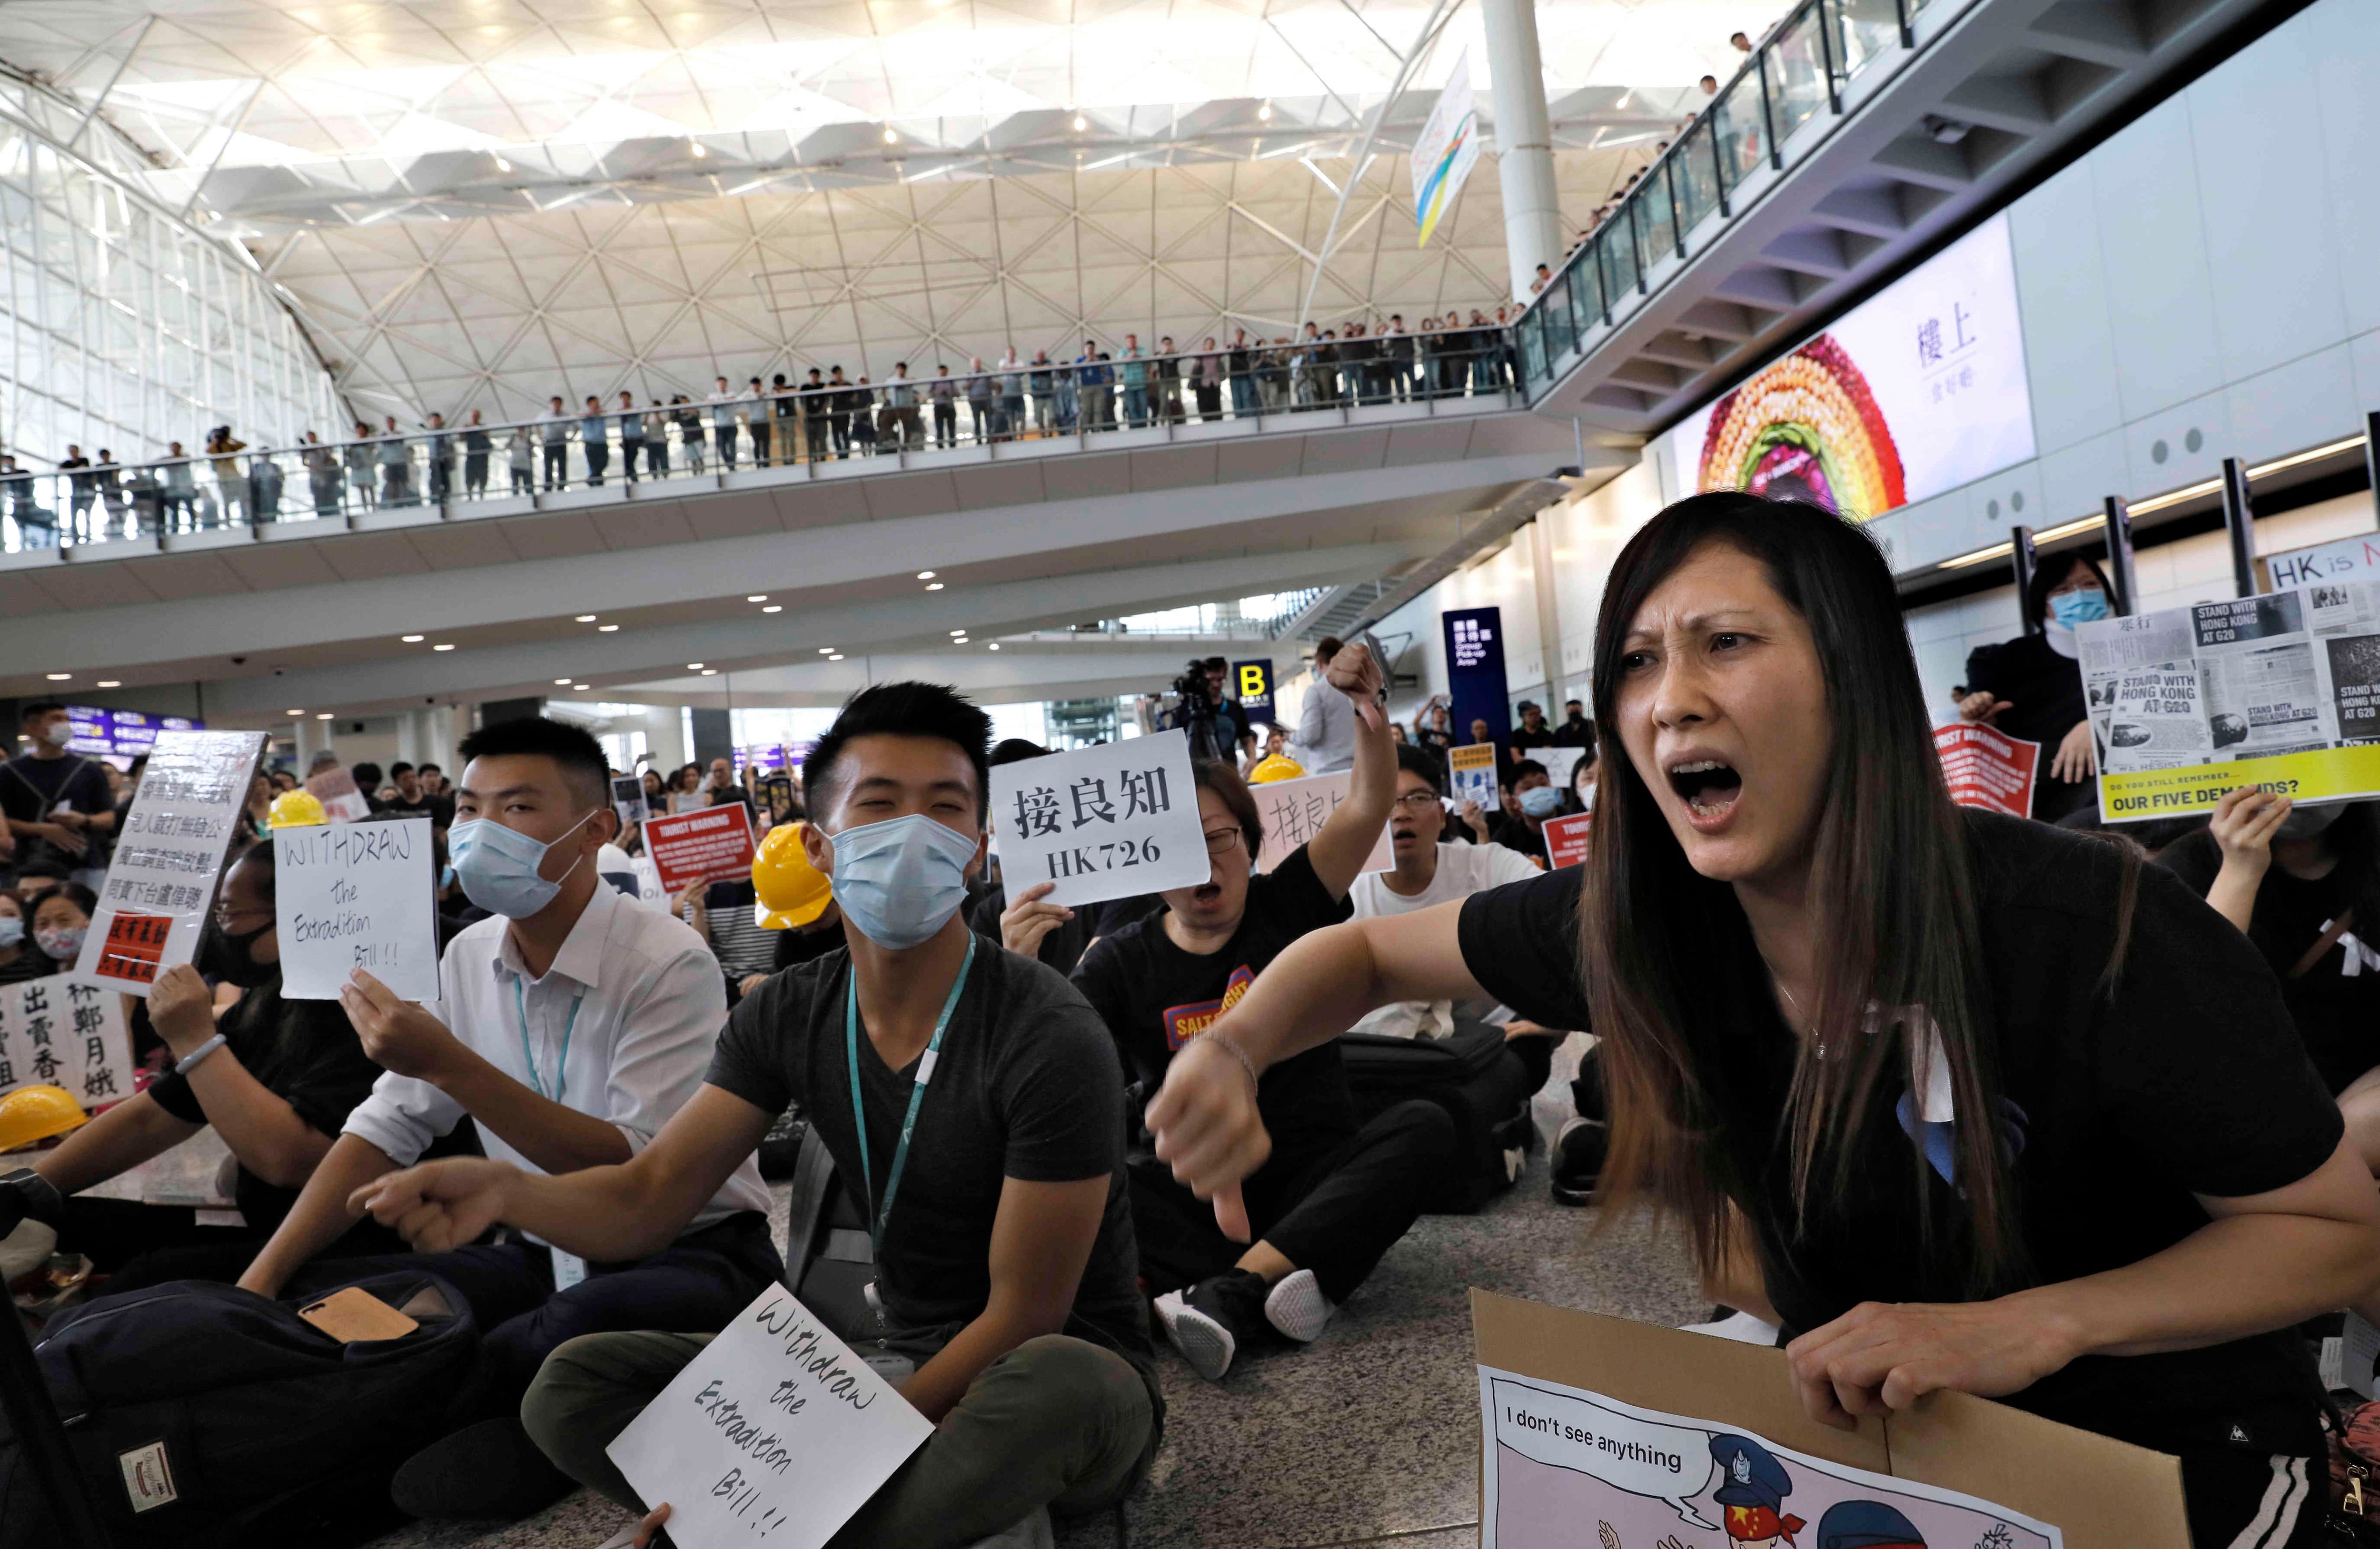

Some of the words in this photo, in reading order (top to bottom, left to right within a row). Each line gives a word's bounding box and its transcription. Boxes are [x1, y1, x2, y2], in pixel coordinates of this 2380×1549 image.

[2273, 553, 2323, 587] HK
[2327, 556, 2354, 572] is
[2198, 604, 2230, 619] STAND
[2231, 601, 2257, 614] WITH
[2200, 618, 2228, 631] HONG
[2231, 613, 2258, 627] KONG
[2203, 632, 2214, 643] AT
[2216, 629, 2235, 641] G20
[1240, 665, 1266, 696] B
[2122, 686, 2156, 700] HONG
[2161, 687, 2195, 699] KONG
[2124, 674, 2160, 688] STAND
[2164, 676, 2195, 686] WITH
[2340, 684, 2370, 697] STAND
[2144, 700, 2160, 713] AT
[2164, 701, 2191, 713] G20
[2248, 705, 2271, 714] STAND
[2273, 702, 2291, 712] WITH
[2292, 709, 2301, 717] AT
[2302, 707, 2317, 716] G20
[2341, 696, 2369, 708] HONG
[2344, 709, 2355, 720] AT
[2357, 707, 2376, 719] G20
[1013, 767, 1170, 839] 接良知
[2113, 797, 2147, 811] OUR
[2153, 791, 2192, 808] FIVE
[1269, 791, 1345, 850] 接良
[285, 824, 411, 868] WITHDRAW
[1046, 835, 1160, 879] HK726
[331, 878, 358, 905] the
[294, 910, 371, 942] Extradition
[1217, 981, 1248, 1015] IGHT
[24, 986, 67, 1090] 出賣香
[756, 1298, 876, 1410] Withdraw
[770, 1379, 806, 1415] the
[694, 1380, 792, 1475] Extradition
[1507, 1407, 1512, 1423] I
[1517, 1410, 1559, 1436] don't
[1565, 1425, 1593, 1446] see
[1597, 1436, 1682, 1473] anything
